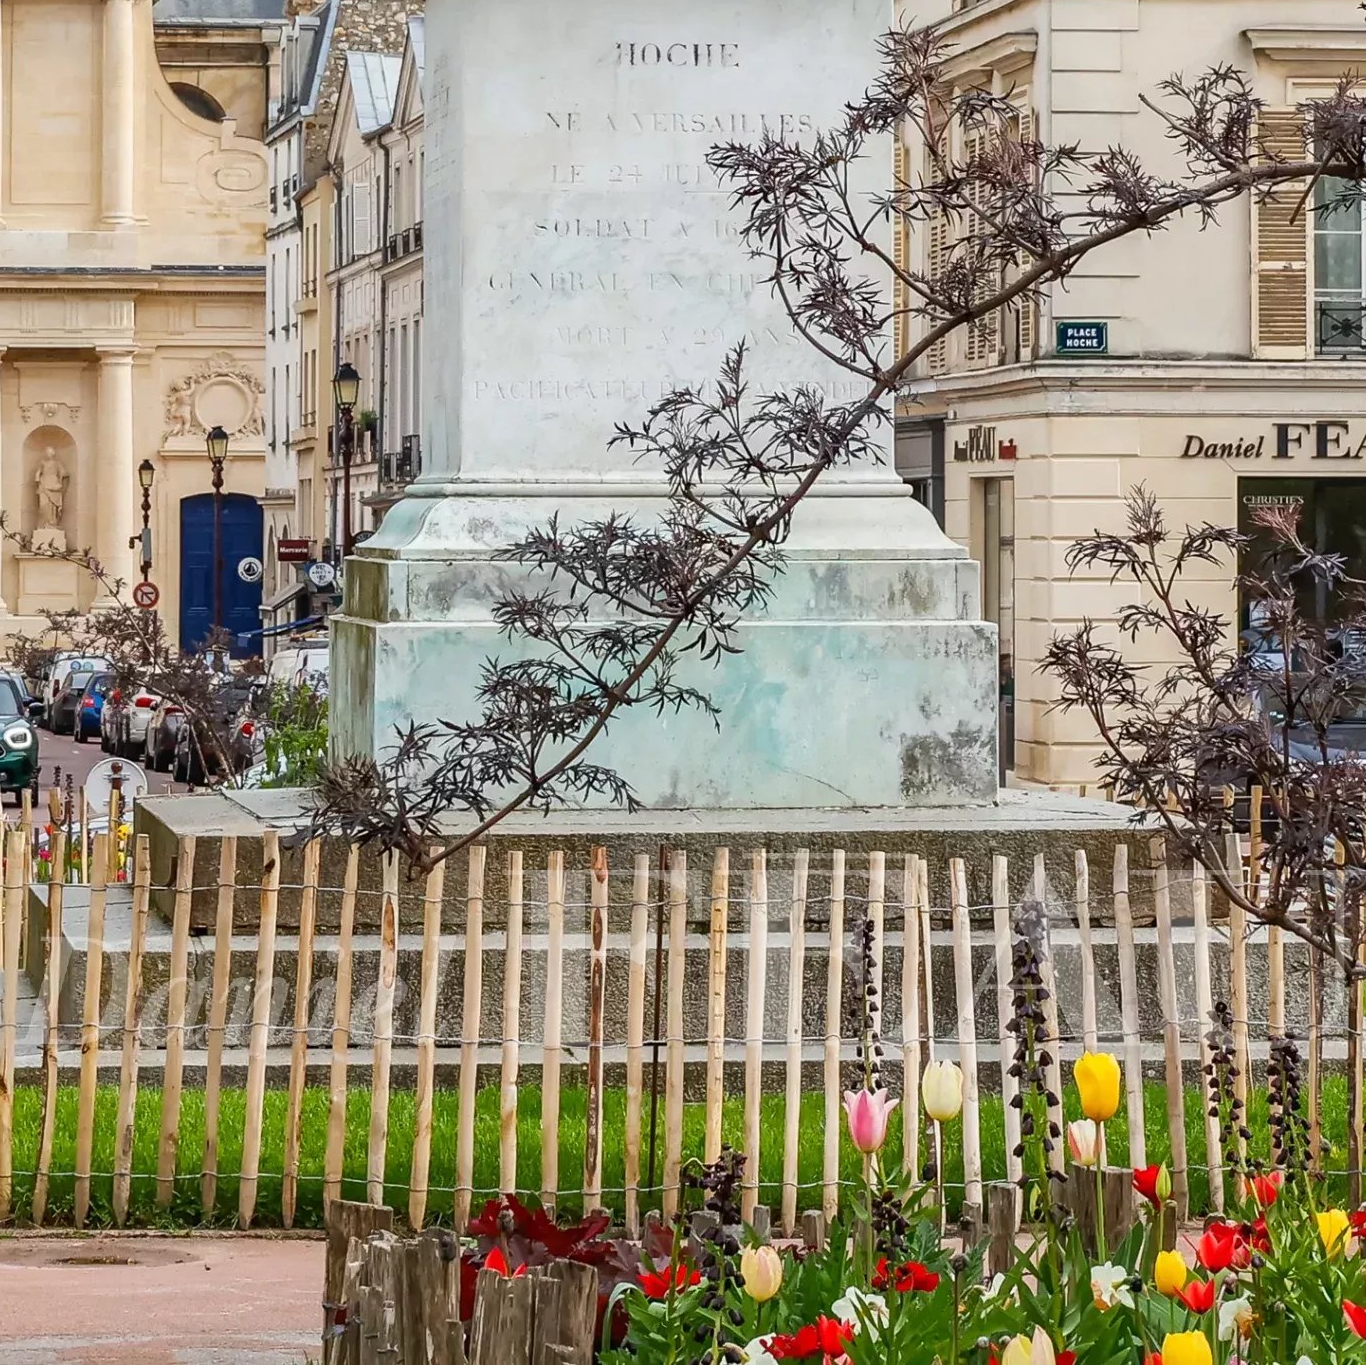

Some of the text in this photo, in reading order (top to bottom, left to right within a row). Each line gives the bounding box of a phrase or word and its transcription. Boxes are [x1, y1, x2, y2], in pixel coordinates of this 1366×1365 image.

[614, 42, 740, 67] HOCHE
[631, 112, 814, 133] VERSAILLES
[550, 164, 585, 184] LE
[607, 164, 643, 184] 24
[534, 219, 655, 237] SOLDAT
[706, 272, 777, 292] CHE
[555, 326, 634, 346] MORT
[1066, 338, 1099, 347] HOCHE
[1067, 328, 1097, 337] PLACE
[1180, 434, 1265, 459] Daniel
